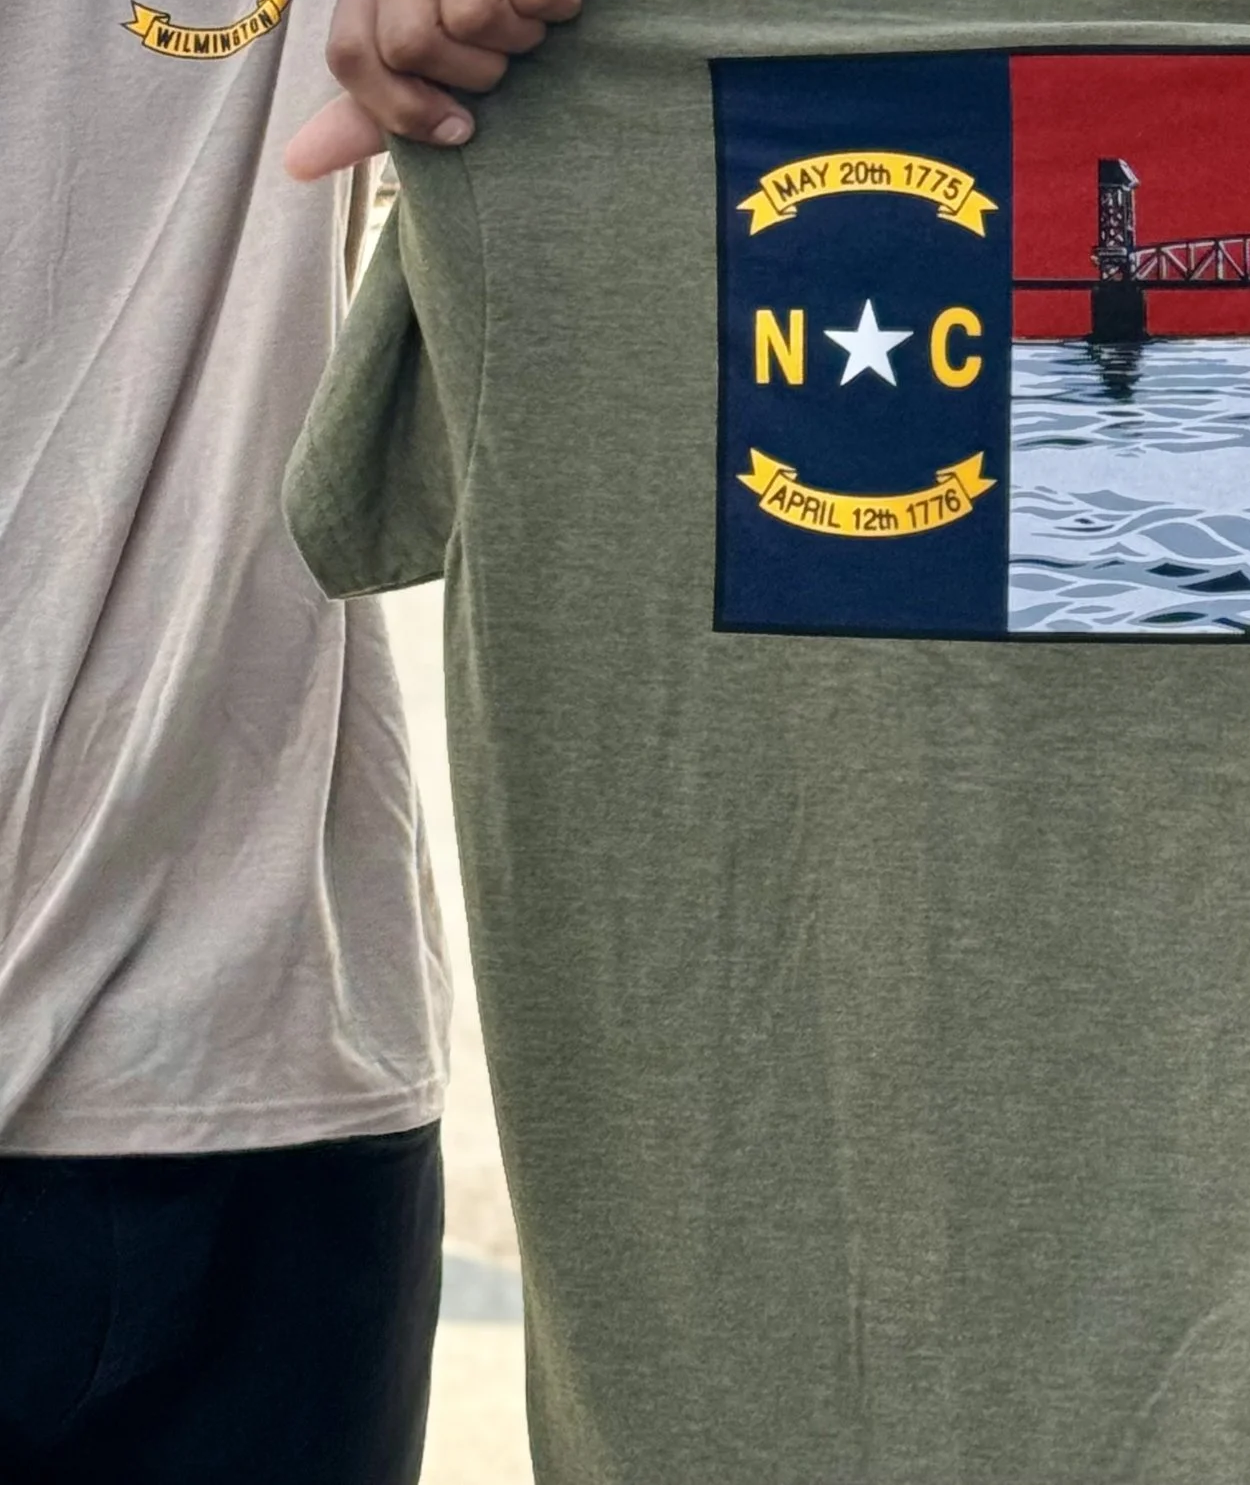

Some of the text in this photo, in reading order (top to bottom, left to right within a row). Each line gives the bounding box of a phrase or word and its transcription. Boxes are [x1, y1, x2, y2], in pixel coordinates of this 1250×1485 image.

[156, 9, 273, 54] WILMINGTON
[772, 161, 963, 203] MAY 20th 1775
[754, 306, 983, 390] N C
[767, 485, 962, 531] APRIL 12th 1776
